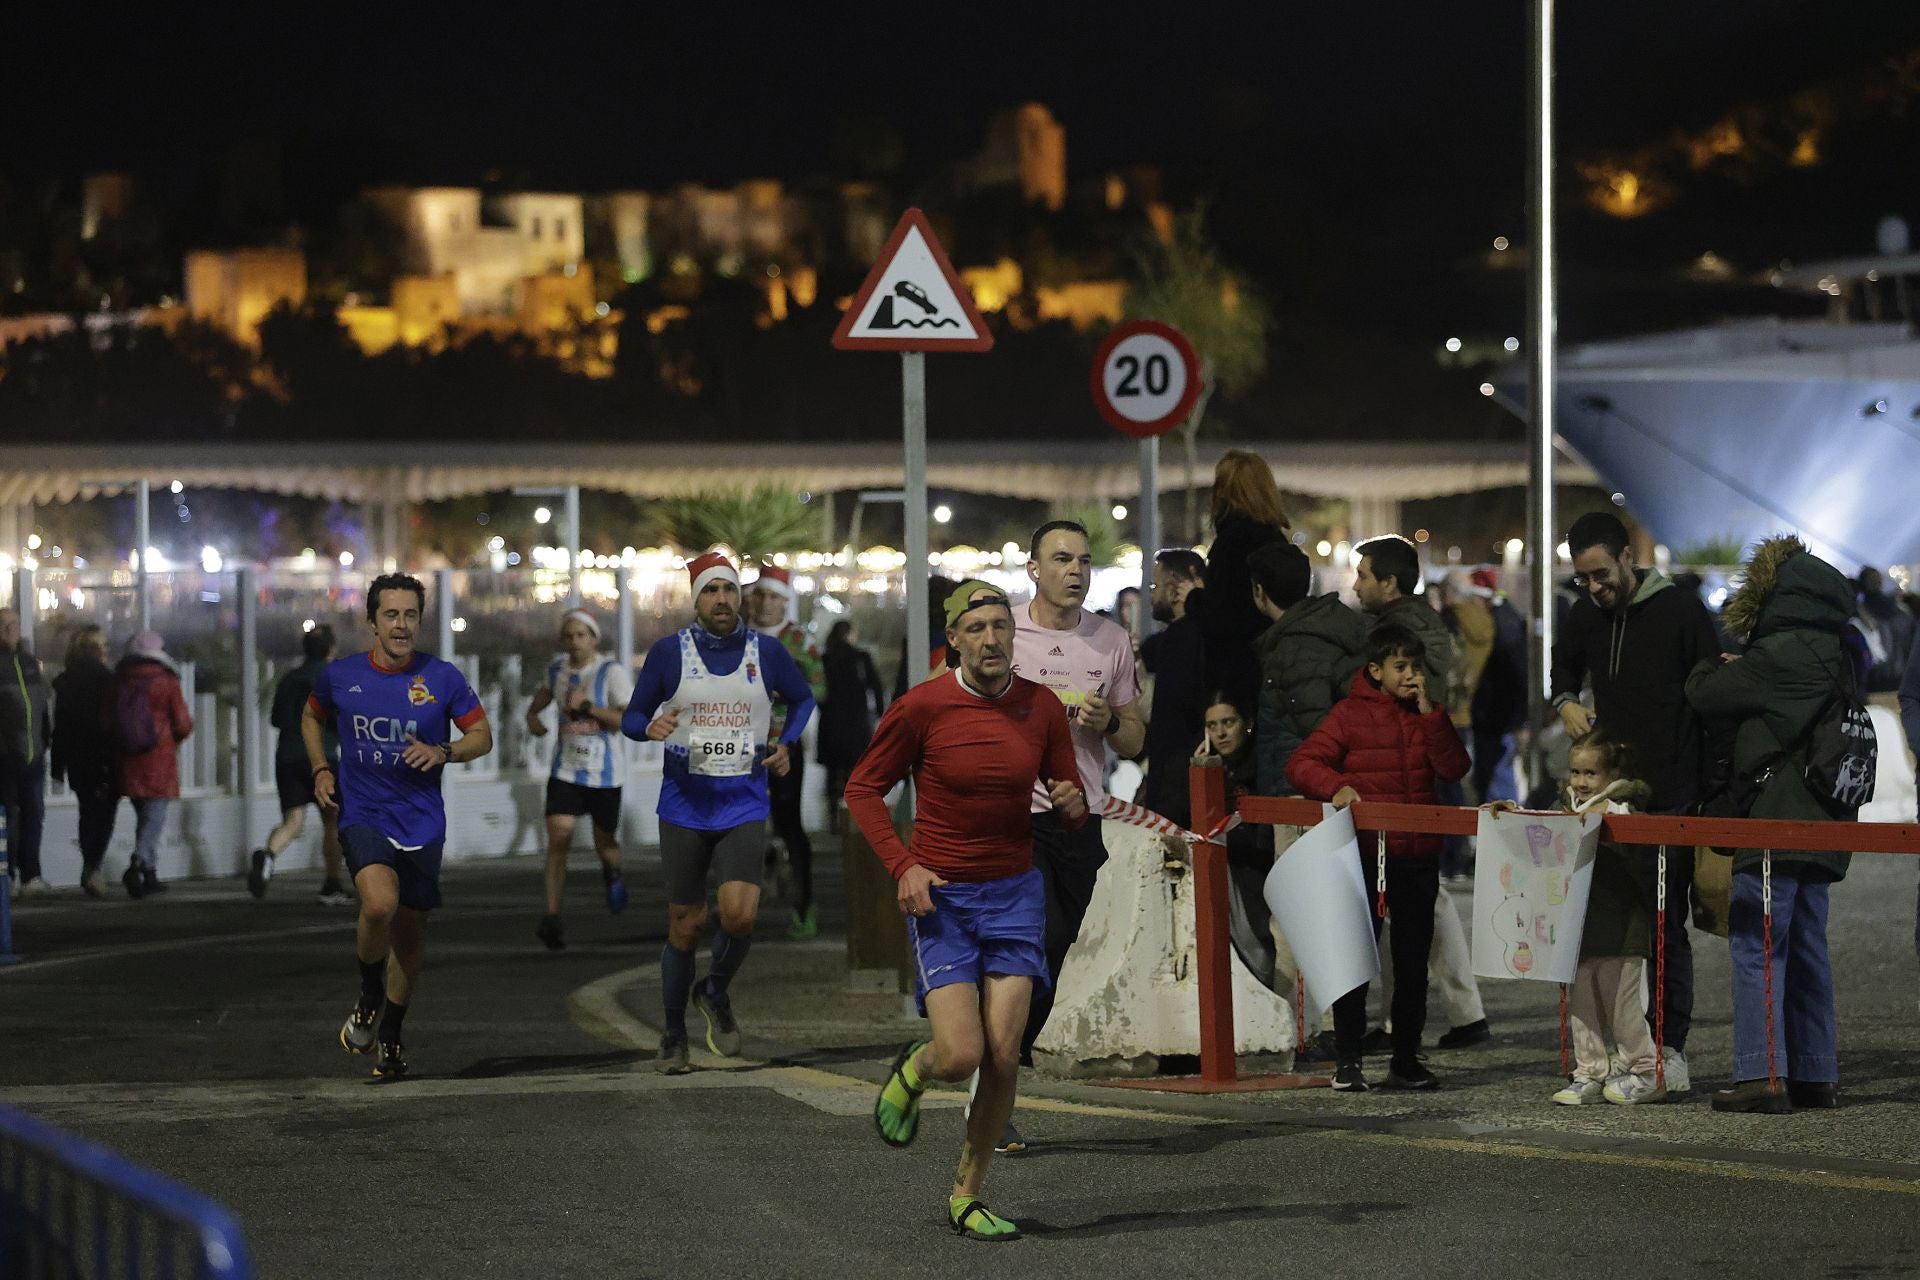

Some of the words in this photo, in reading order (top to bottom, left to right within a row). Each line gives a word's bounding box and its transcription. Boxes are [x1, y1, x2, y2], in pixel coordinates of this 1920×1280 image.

[1115, 354, 1169, 397] 20
[691, 700, 752, 714] TRIATLÓN
[690, 715, 751, 727] ARGANDA
[353, 715, 418, 742] RCM
[702, 742, 735, 755] 668
